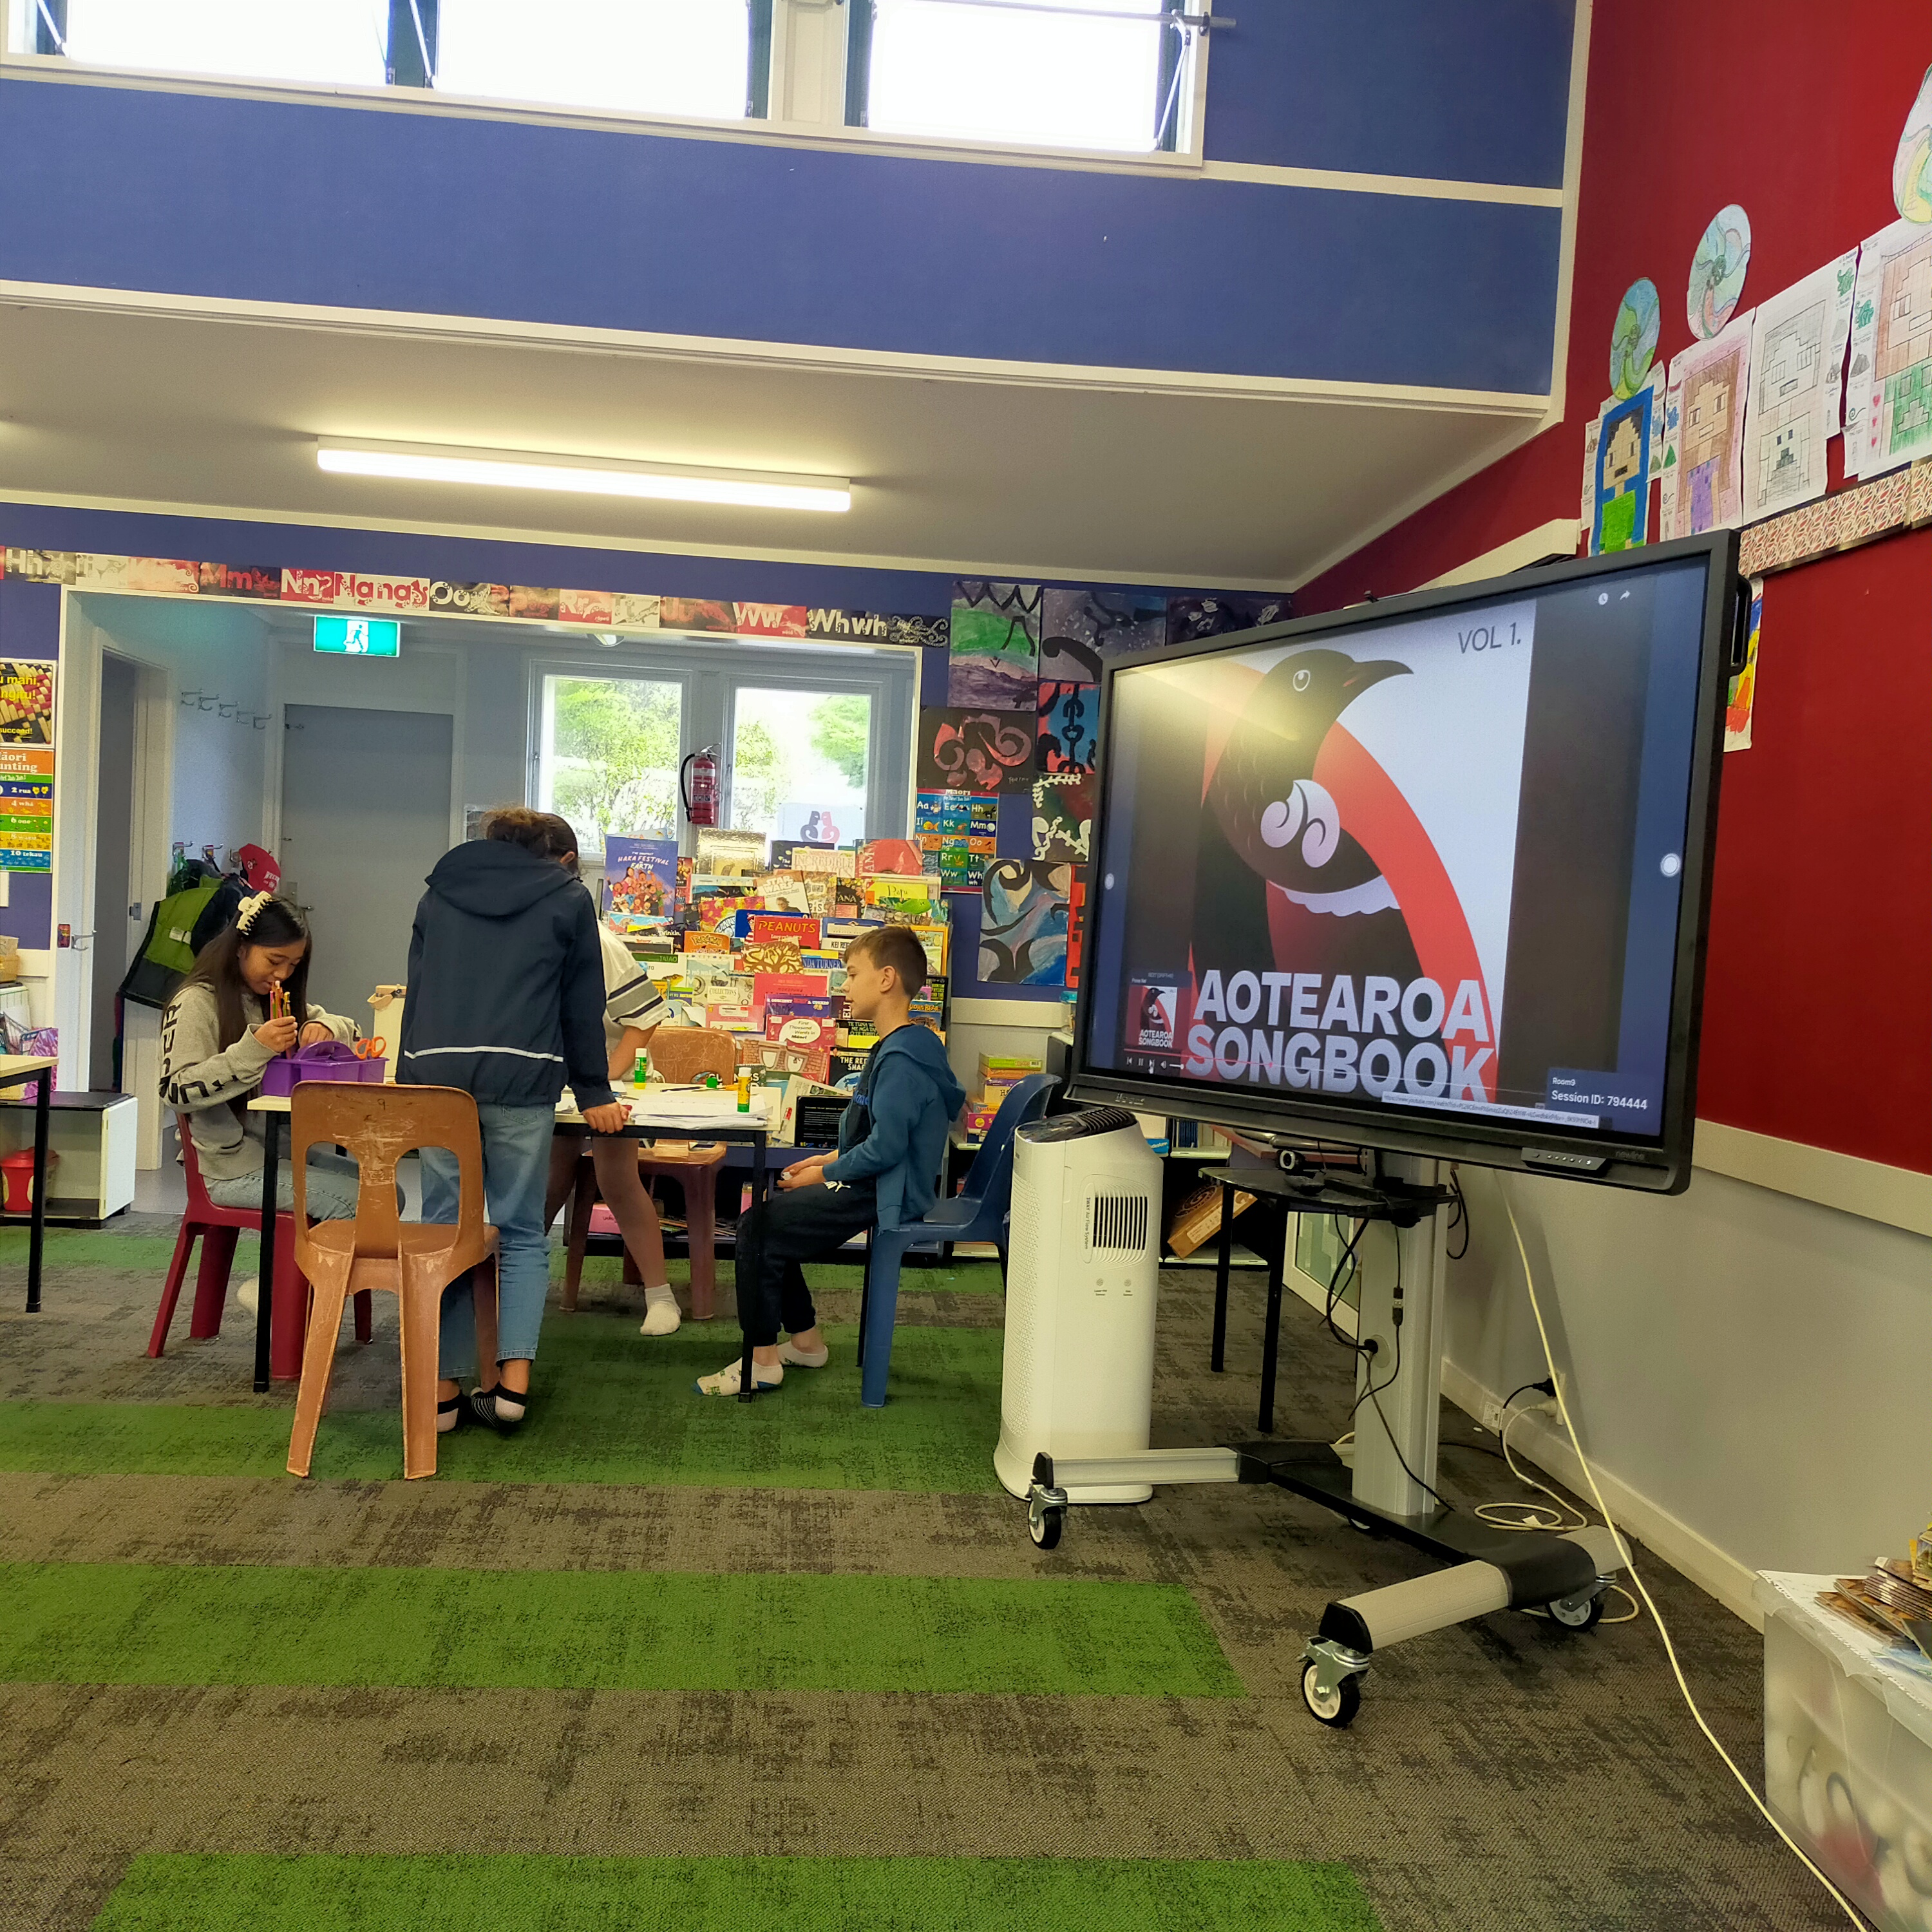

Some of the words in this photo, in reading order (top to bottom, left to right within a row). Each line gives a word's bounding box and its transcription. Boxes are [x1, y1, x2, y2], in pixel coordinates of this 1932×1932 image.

[281, 569, 319, 595] Nn
[430, 581, 471, 607] Oo
[732, 601, 783, 629] Ww
[1457, 625, 1502, 654] VOL
[1509, 621, 1522, 646] 1.
[7, 676, 41, 687] mahi,
[0, 751, 26, 762] āori
[917, 800, 929, 810] Aa
[971, 804, 983, 813] Hh
[916, 817, 923, 826] Ii
[943, 819, 955, 828] Kk
[970, 821, 987, 829] Mm
[942, 837, 955, 848] Ng
[969, 838, 982, 846] Oo
[638, 855, 670, 866] FESTIVAL
[795, 855, 854, 868] INCREDIBLE
[941, 852, 953, 861] Rr
[969, 854, 980, 863] Tt
[766, 875, 793, 886] STAR
[940, 869, 958, 877] Ww
[967, 871, 983, 880] Wh
[762, 882, 795, 894] WARS
[758, 920, 817, 933] PEANUTS
[817, 959, 840, 969] TURNER
[709, 988, 737, 996] COLLECTIONS
[1193, 969, 1491, 1042] AOTEAROA
[1139, 1028, 1174, 1039] AOTEAROA
[1138, 1036, 1174, 1048] SONGBOOK
[1186, 1024, 1495, 1103] SONGBOOK
[1551, 1076, 1576, 1086] Room9
[1551, 1090, 1589, 1104] Session
[1591, 1092, 1605, 1105] ID:
[1607, 1095, 1647, 1110] 794444
[1615, 1149, 1645, 1160] newline
